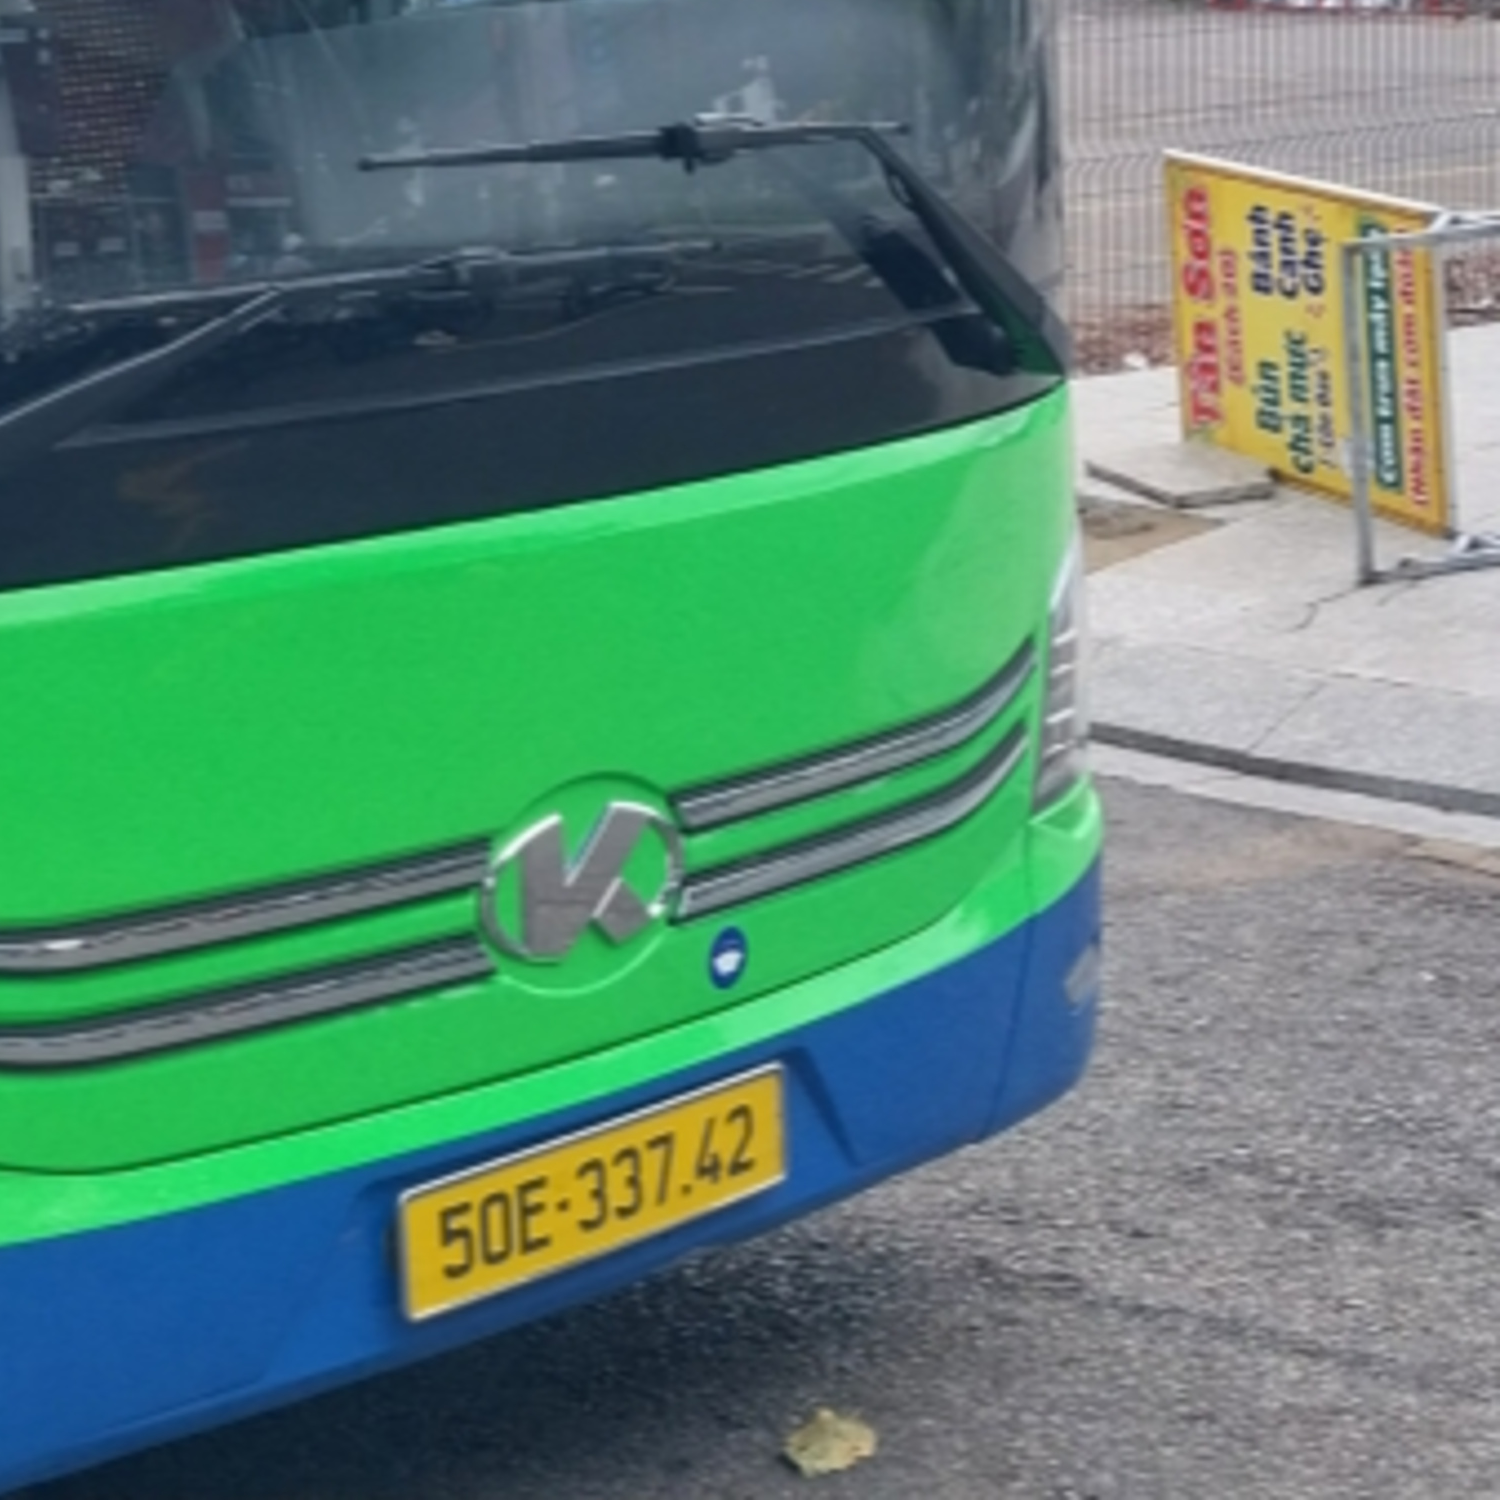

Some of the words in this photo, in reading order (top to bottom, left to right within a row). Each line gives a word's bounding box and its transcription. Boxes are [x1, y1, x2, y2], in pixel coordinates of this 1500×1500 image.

[1181, 185, 1213, 300] Sơn
[1245, 204, 1274, 296] Bánh
[1273, 209, 1298, 300] Canh
[1185, 319, 1222, 428] Tân
[438, 1104, 756, 1279] 50E-337.42
